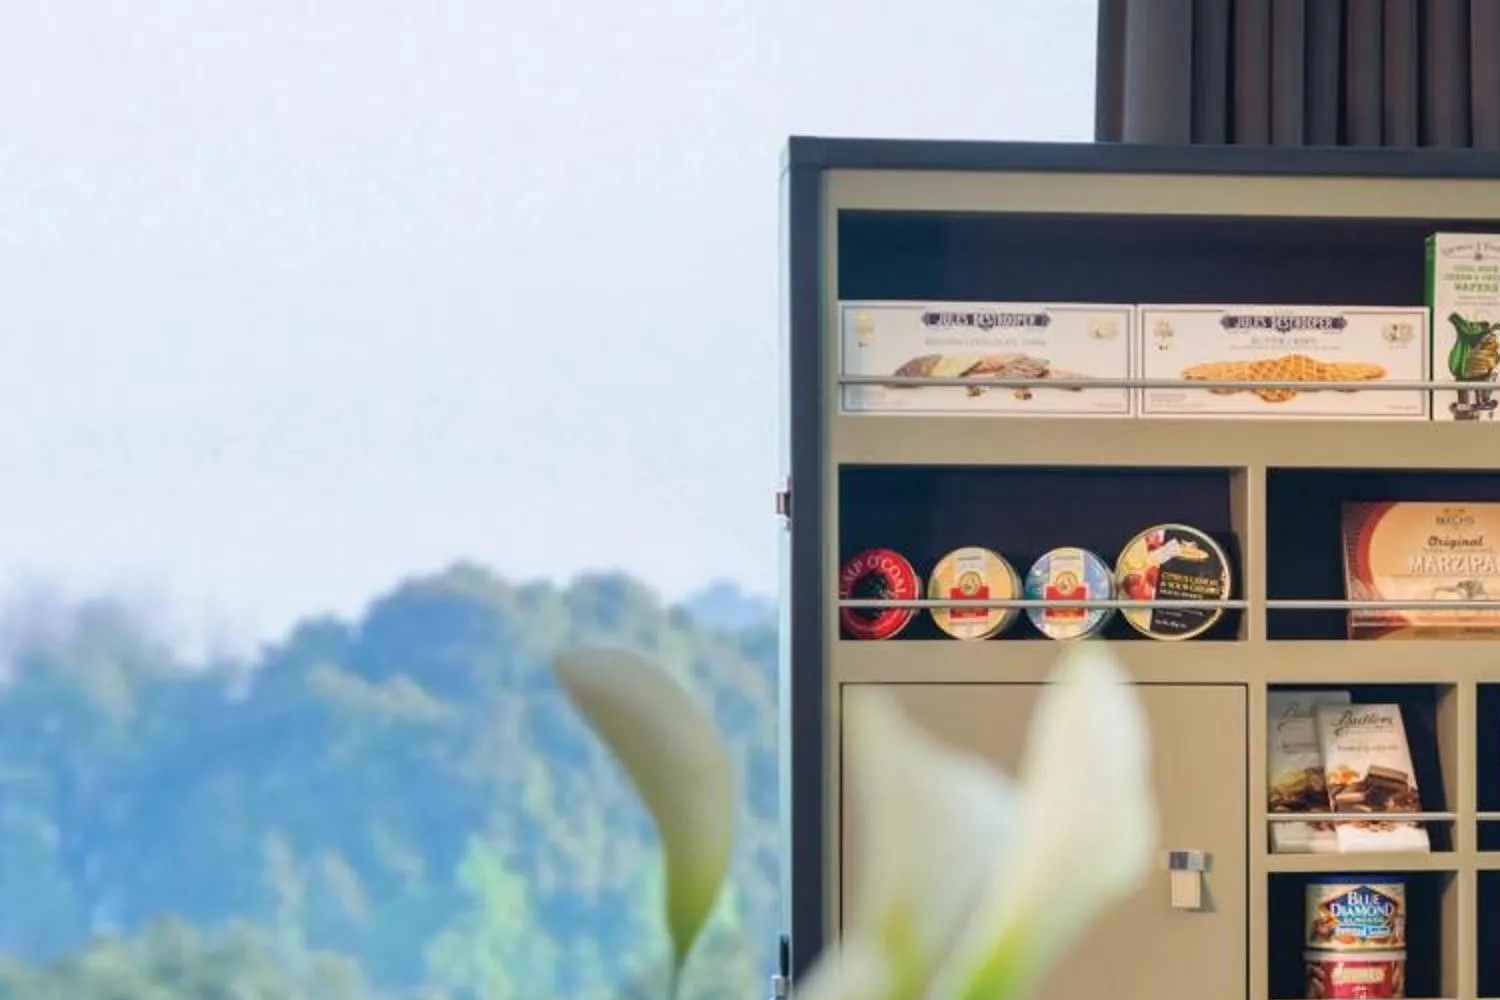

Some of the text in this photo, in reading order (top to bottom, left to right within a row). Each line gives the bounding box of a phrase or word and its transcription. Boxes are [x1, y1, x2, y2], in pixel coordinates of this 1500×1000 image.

[1237, 315, 1269, 329] JULES
[1428, 535, 1484, 551] Original
[1347, 891, 1379, 905] BLUE
[1331, 903, 1395, 917] DIAMOND
